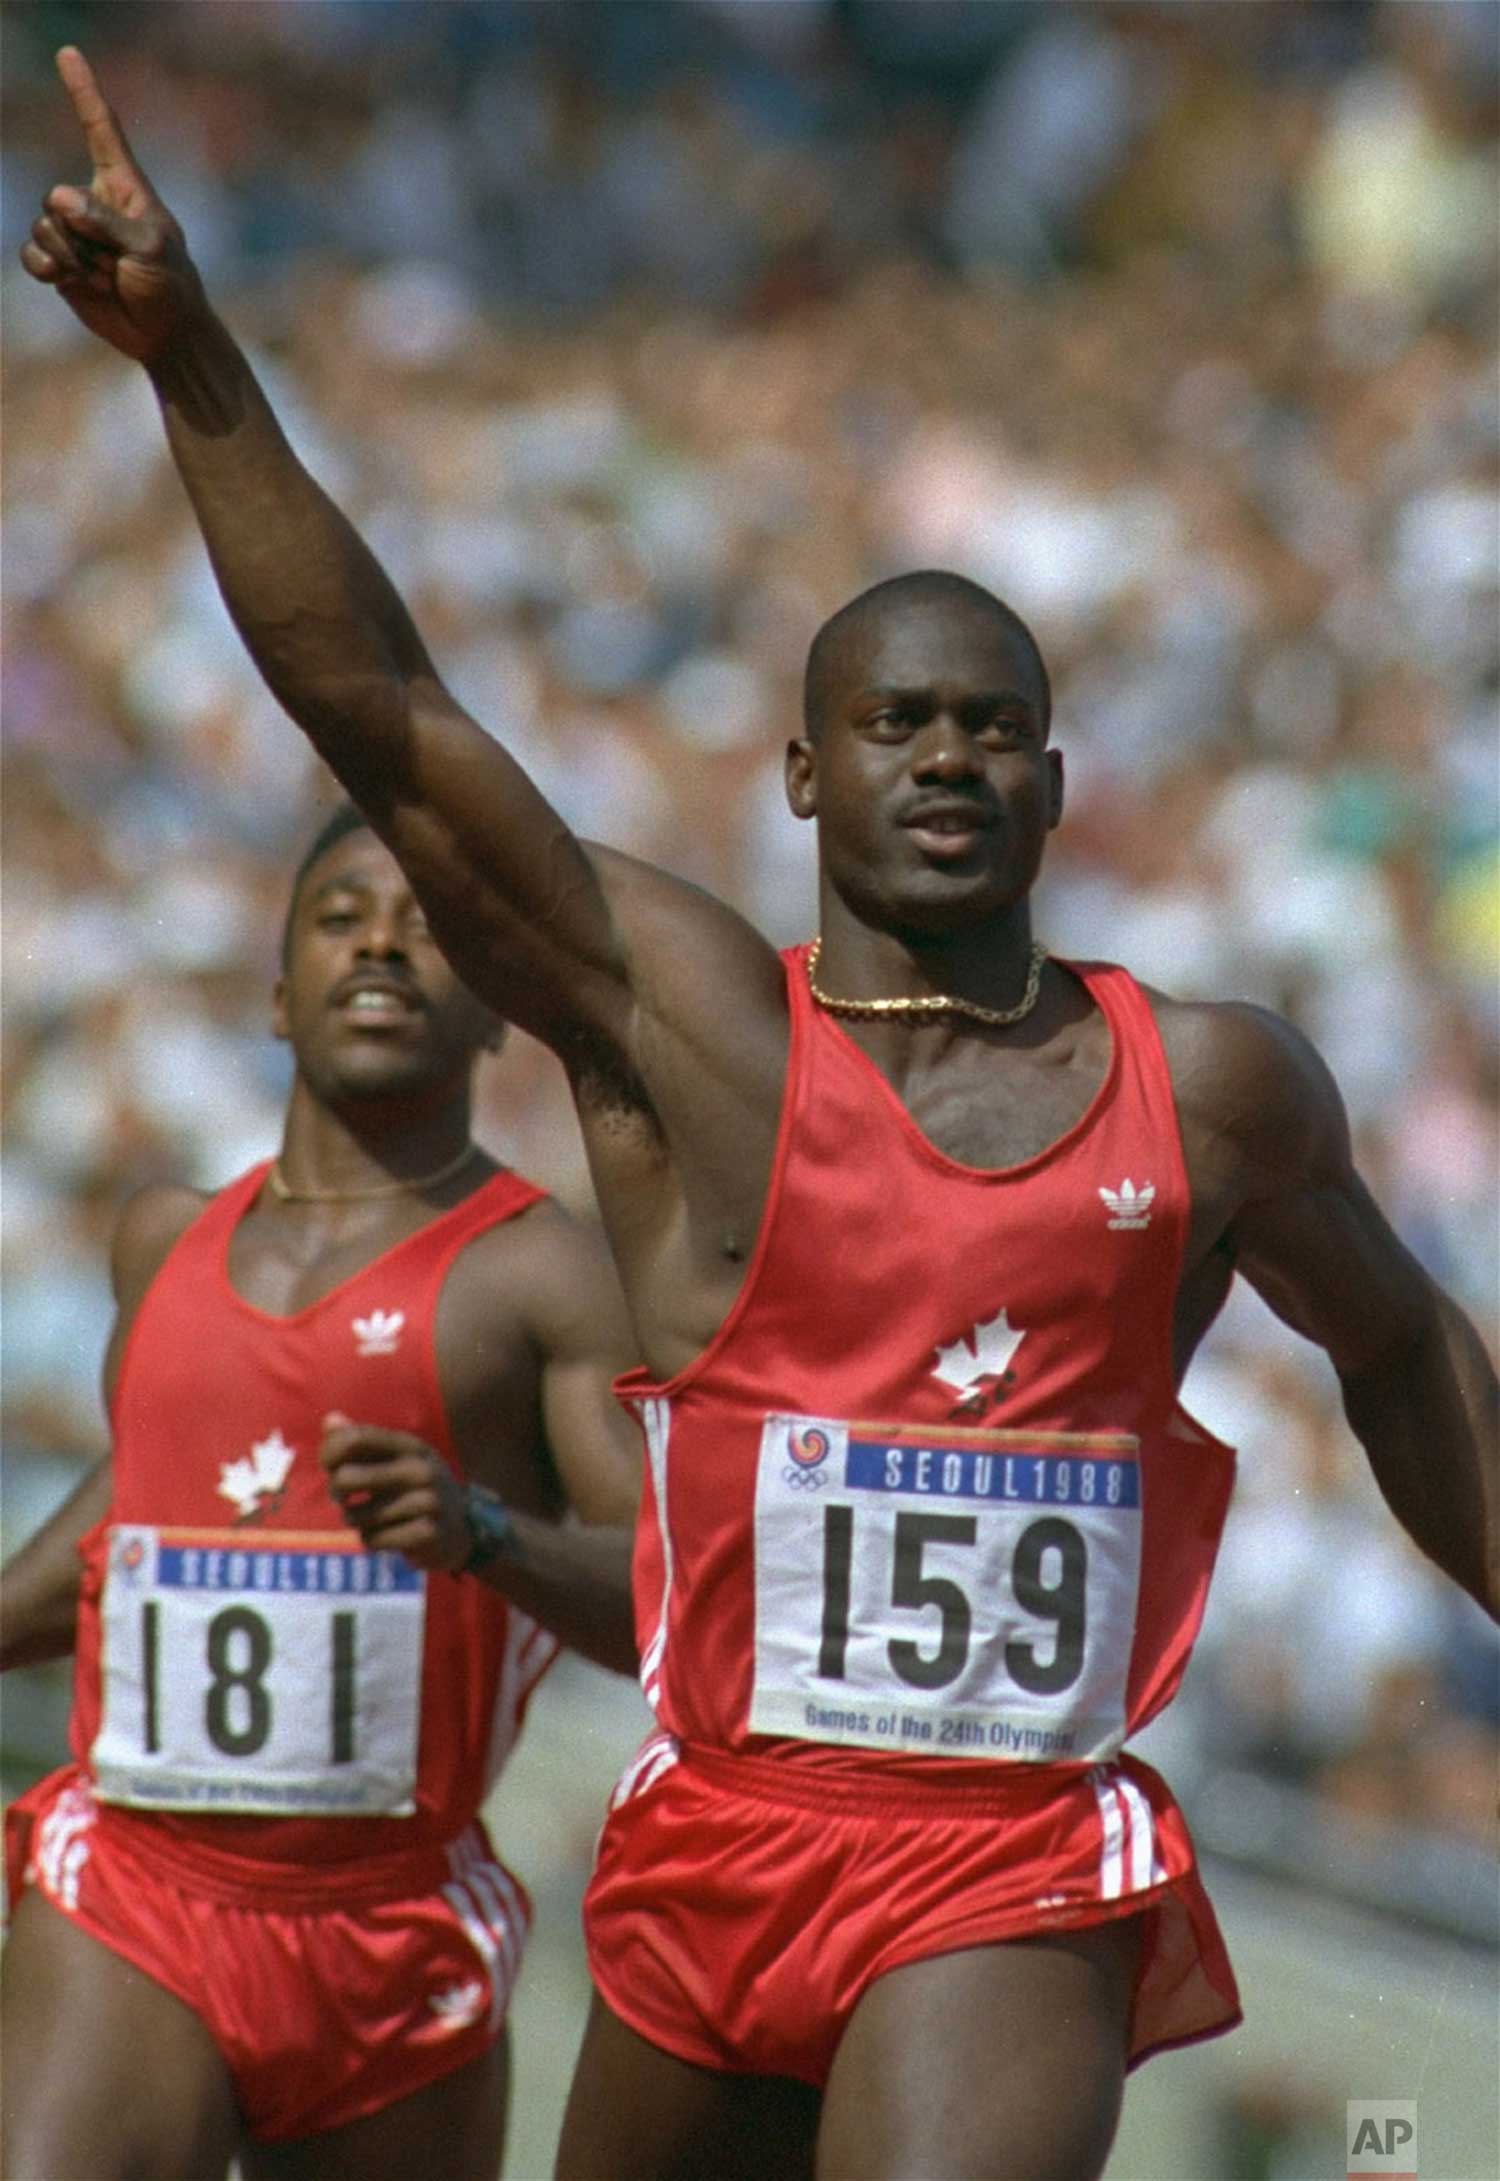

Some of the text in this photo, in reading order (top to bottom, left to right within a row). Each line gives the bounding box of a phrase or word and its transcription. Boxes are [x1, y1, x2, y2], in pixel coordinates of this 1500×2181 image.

[818, 1504, 1088, 1696] 159
[143, 1602, 357, 1763] 181
[804, 1703, 870, 1732] Games
[876, 1713, 896, 1735] of
[902, 1714, 932, 1740] the
[940, 1719, 985, 1745] 24th
